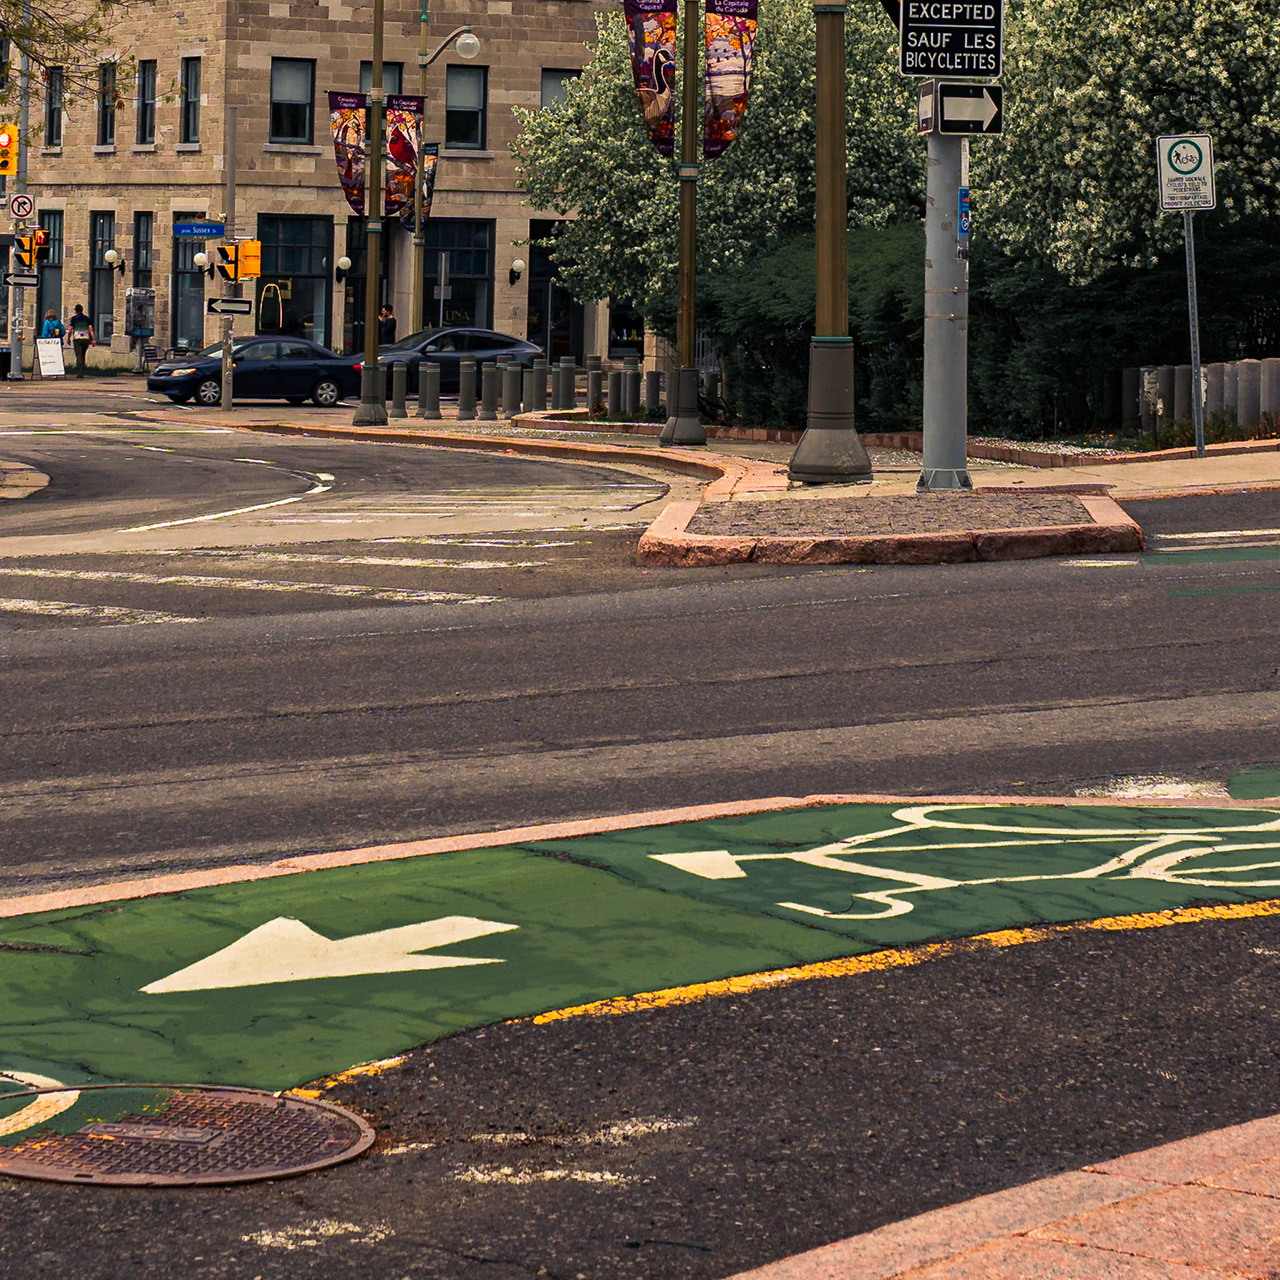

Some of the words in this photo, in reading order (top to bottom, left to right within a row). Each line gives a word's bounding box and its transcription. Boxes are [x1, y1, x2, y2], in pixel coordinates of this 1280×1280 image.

[909, 2, 995, 20] EXCEPTED
[907, 31, 952, 48] SAUF
[964, 33, 996, 49] LES
[906, 51, 996, 70] BICYCLETTES
